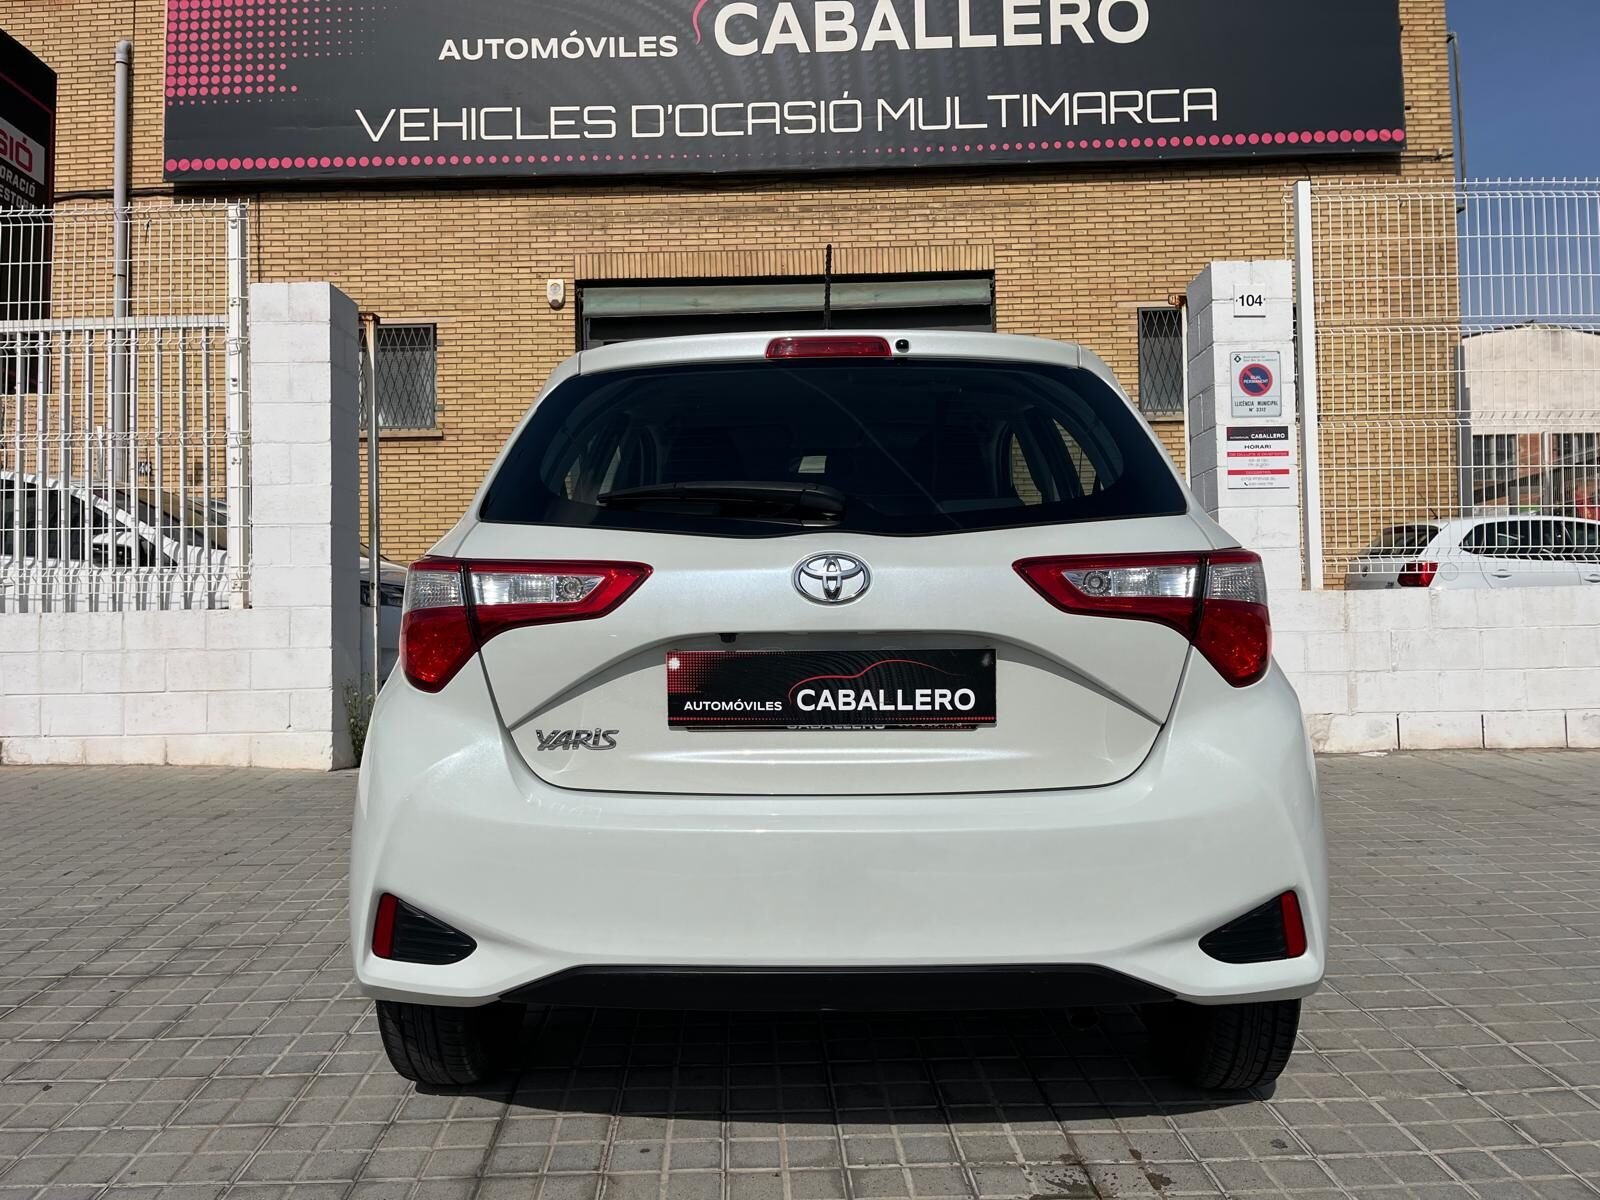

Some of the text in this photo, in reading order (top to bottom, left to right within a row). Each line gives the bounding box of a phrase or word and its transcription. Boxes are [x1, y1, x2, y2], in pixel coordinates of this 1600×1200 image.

[438, 0, 1151, 60] AUTOMÓVILES CABALLERO
[354, 87, 1218, 142] VEHICLES D'OCASIÓ MULTIMARCA
[1238, 294, 1263, 307] 104
[684, 688, 976, 712] AUTOMÓVILES CABALLERO
[536, 728, 620, 751] YARIS
